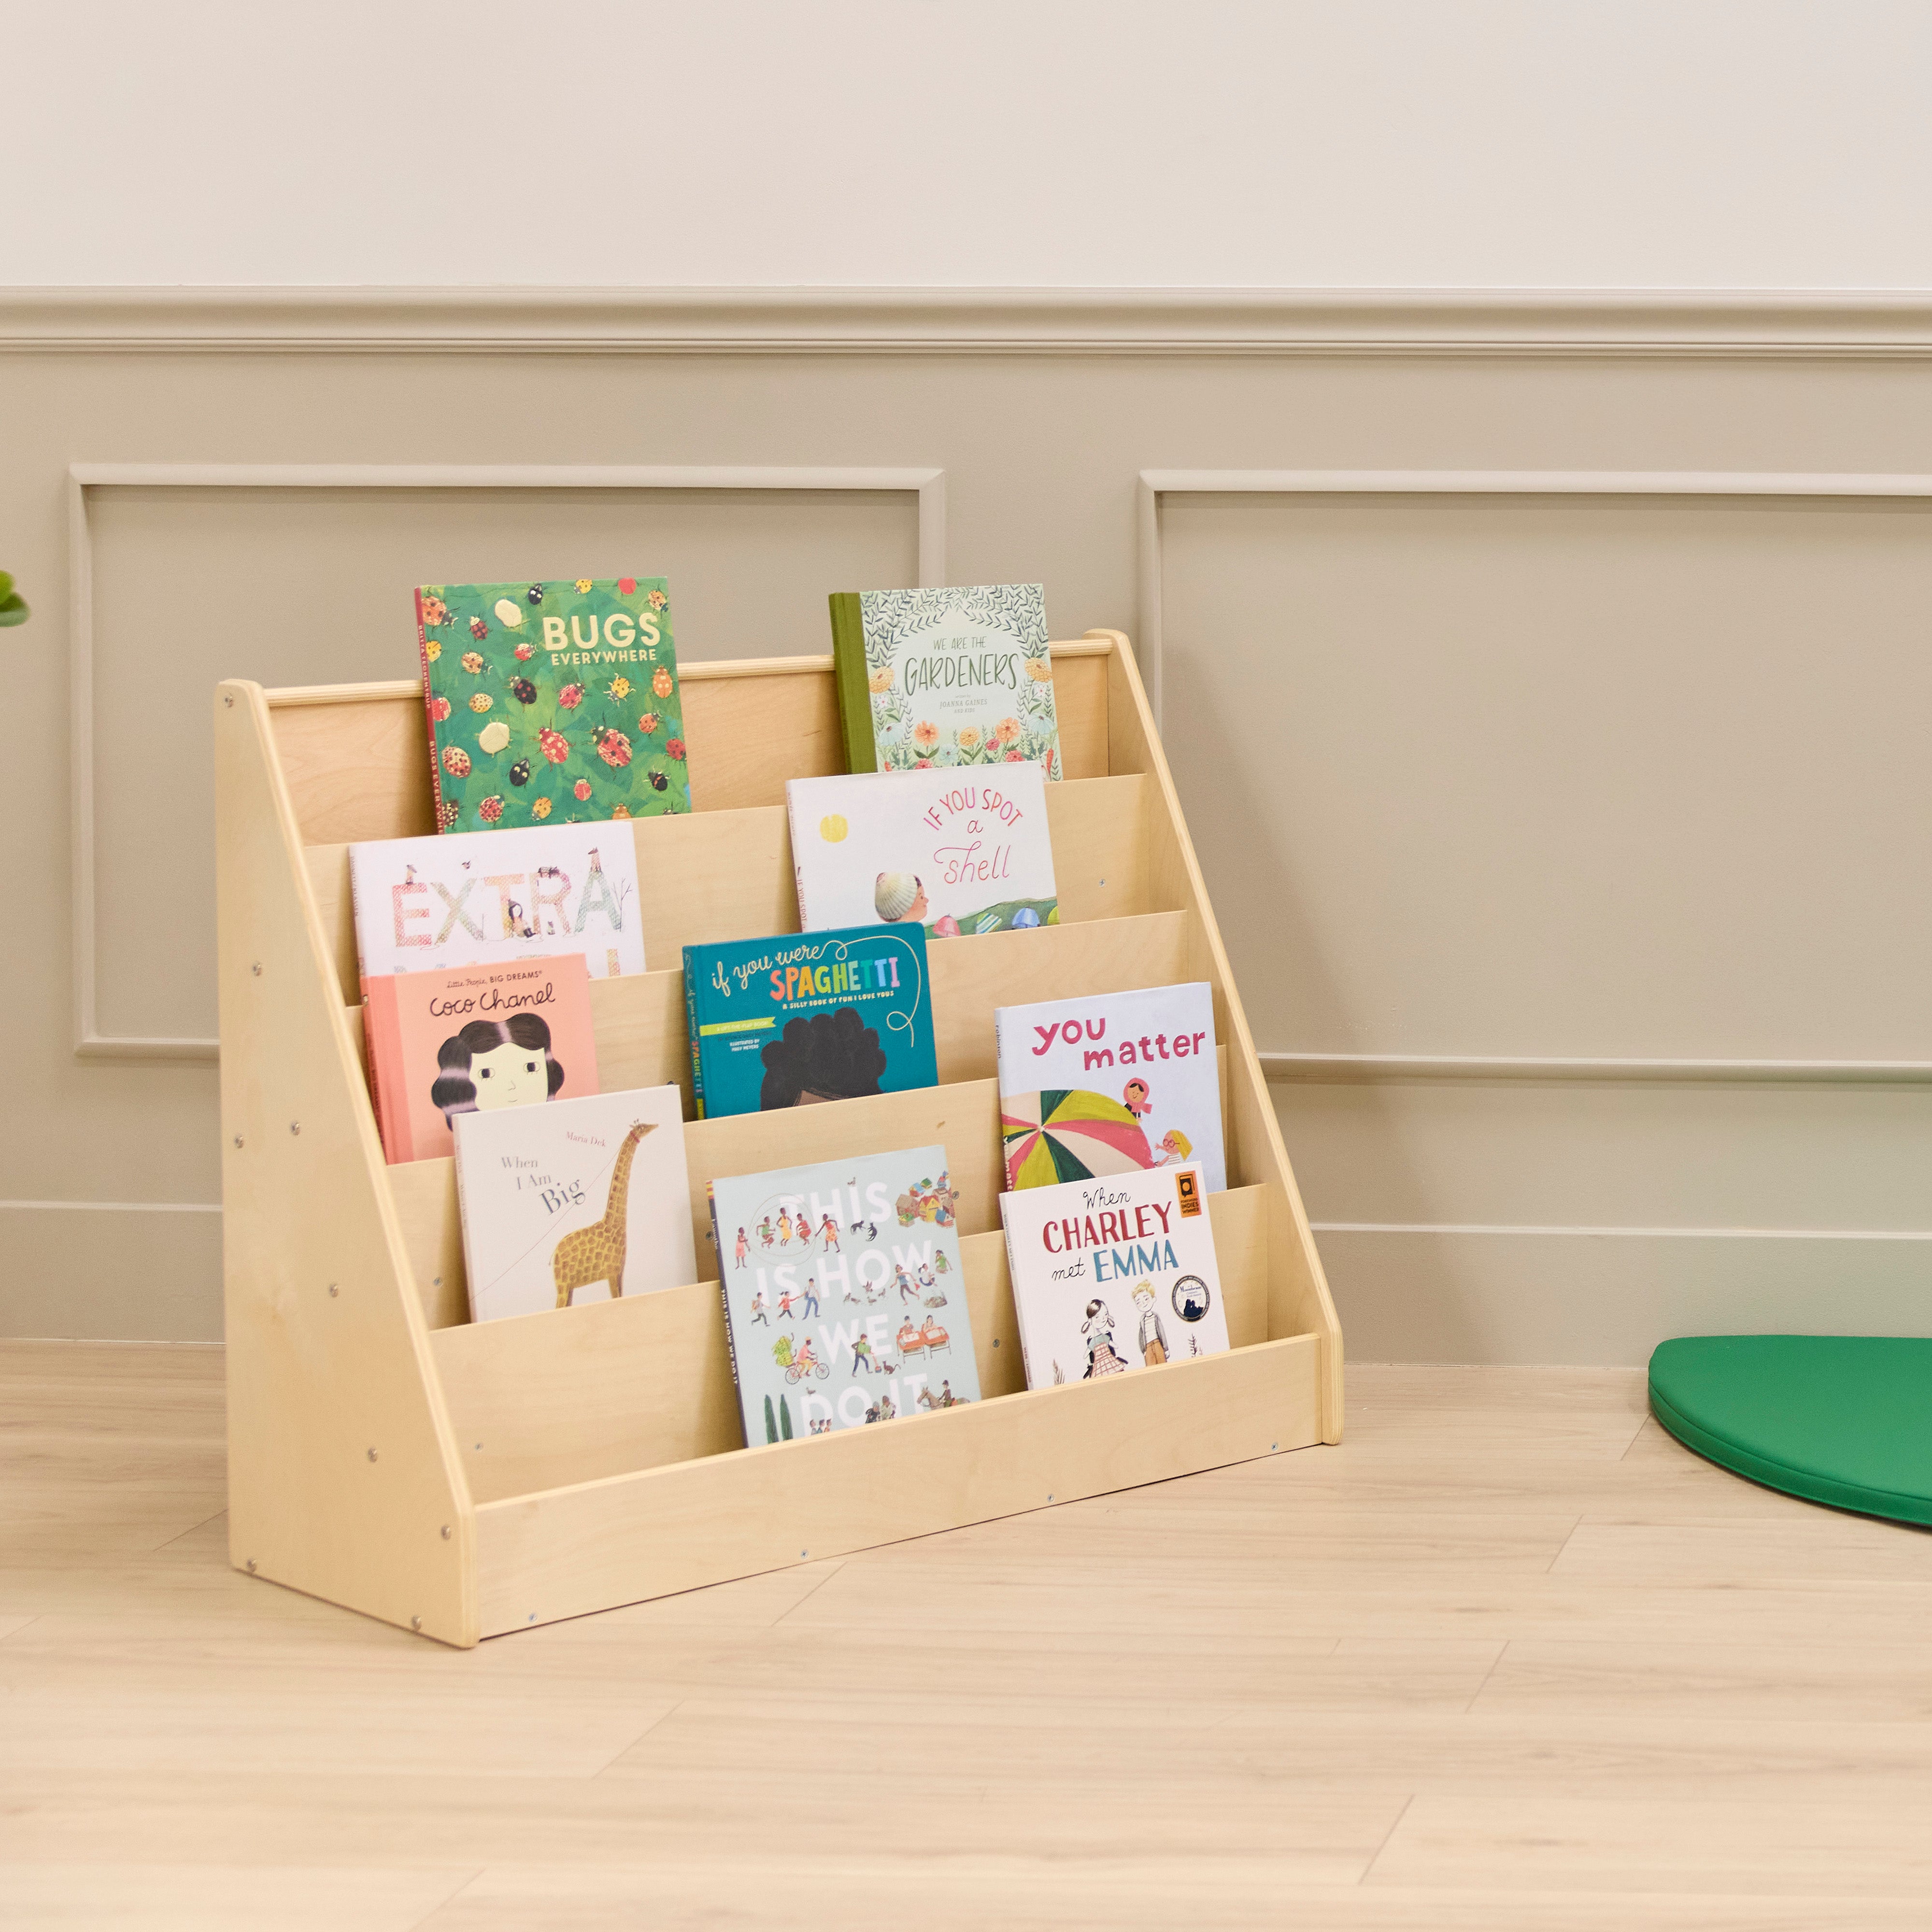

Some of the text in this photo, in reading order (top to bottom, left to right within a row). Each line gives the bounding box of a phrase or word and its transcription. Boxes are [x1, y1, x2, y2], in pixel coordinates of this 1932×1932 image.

[542, 612, 660, 651] BUGS
[933, 636, 987, 650] WE ARE THE
[551, 649, 657, 666] EVERYWHERE
[905, 653, 1019, 696] GARDENERS
[422, 656, 431, 709] TECKENTRUP
[939, 700, 963, 710] JOANNA
[433, 774, 444, 835] EVERYWHE
[923, 787, 1023, 830] IF YOU SPOT
[967, 820, 983, 834] a
[934, 841, 1011, 884] shell
[392, 871, 622, 948] EXTRA
[490, 975, 504, 983] BIG
[711, 945, 824, 997] if you were
[770, 957, 900, 1001] SPAGHETTI
[430, 982, 555, 1017] Coco Chanel
[877, 990, 894, 998] YOUS
[1032, 1018, 1106, 1056] you
[1084, 1032, 1206, 1071] matter
[691, 1041, 702, 1093] SPAGHETTI
[567, 1131, 606, 1147] Maria Dek
[501, 1156, 538, 1168] When
[517, 1174, 552, 1190] I Am
[538, 1179, 586, 1216] Big
[1083, 1187, 1131, 1209] When
[780, 1181, 893, 1232] THIS
[1043, 1201, 1172, 1253] CHARLEY
[756, 1240, 933, 1307] IS HOW
[1051, 1239, 1179, 1282] met EMMA
[724, 1311, 729, 1320] IS
[729, 1345, 734, 1358] WE
[818, 1314, 894, 1365] WE
[731, 1361, 737, 1374] DO
[800, 1373, 929, 1437] DO IT
